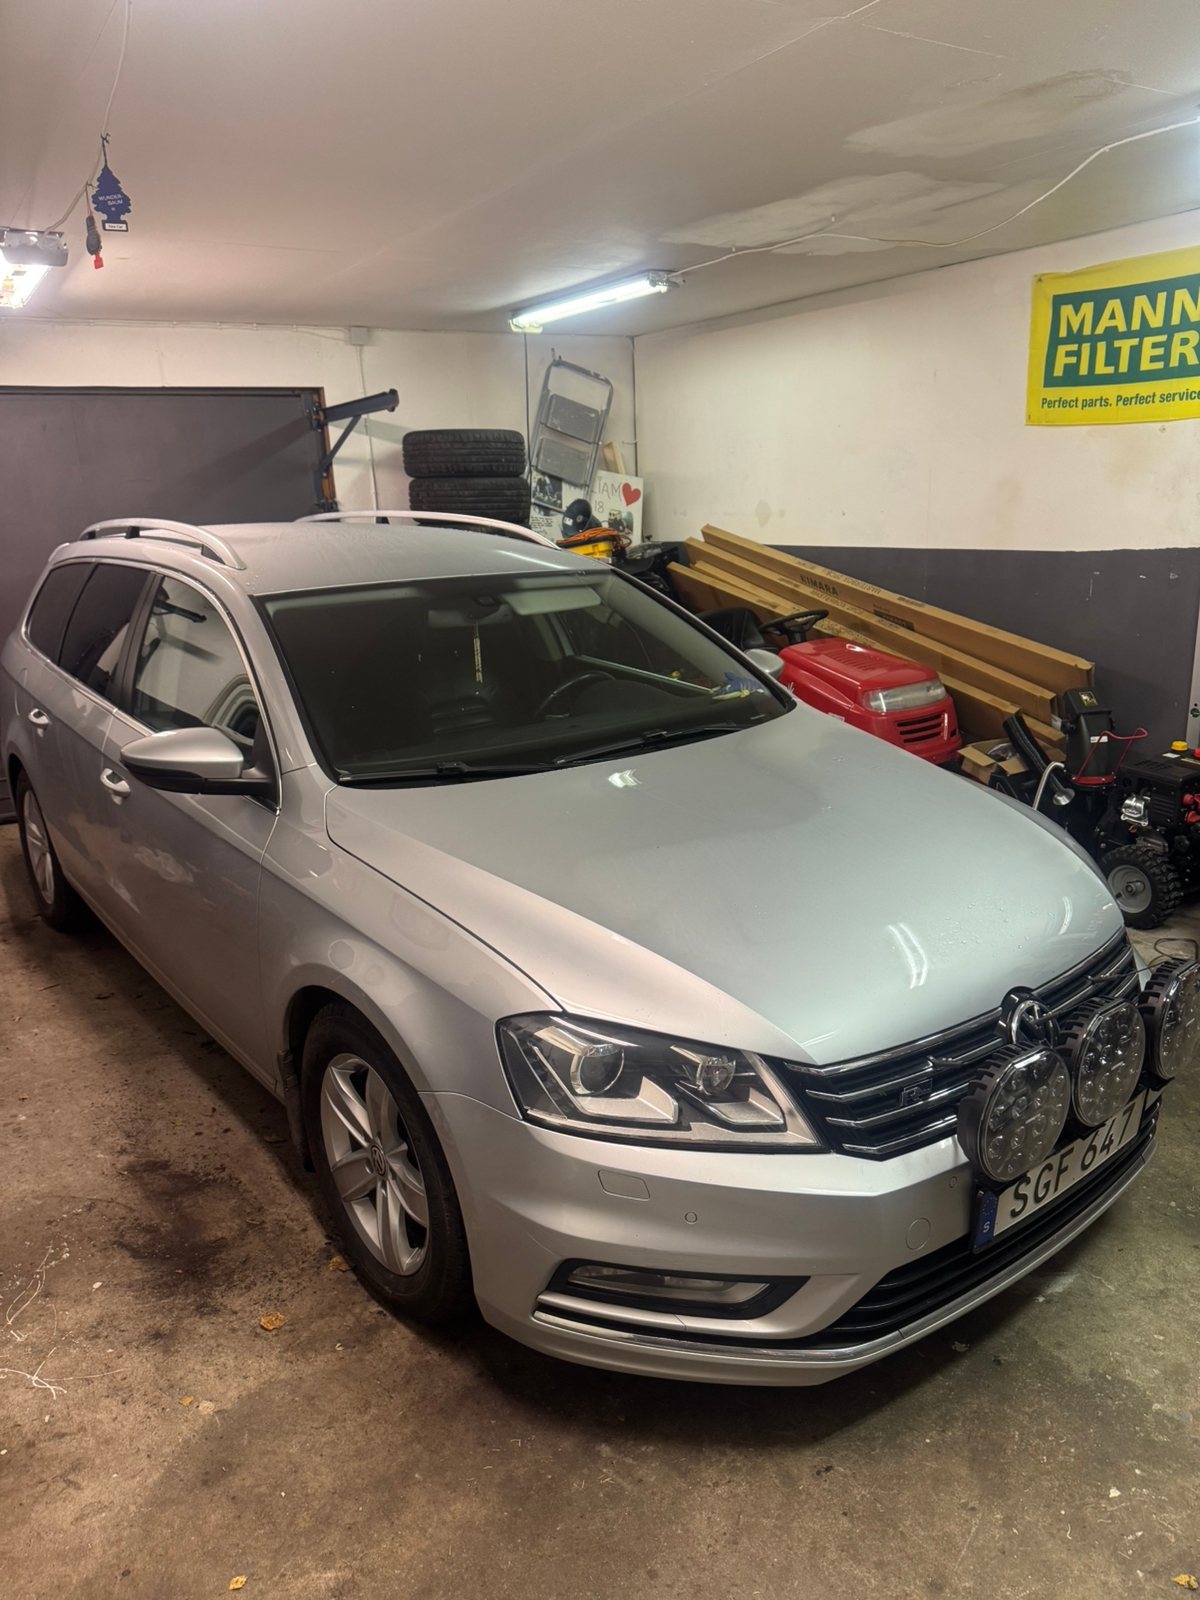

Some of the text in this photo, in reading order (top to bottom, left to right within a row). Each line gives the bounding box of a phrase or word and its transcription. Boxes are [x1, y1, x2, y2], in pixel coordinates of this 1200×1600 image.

[1058, 286, 1200, 338] MANN
[1053, 330, 1200, 377] FILTER
[1041, 388, 1200, 410] Perfect parts. Perfect service
[594, 500, 605, 513] 18
[800, 574, 839, 596] KIMARA
[1010, 1101, 1136, 1218] SGF 647
[982, 1221, 990, 1233] S
